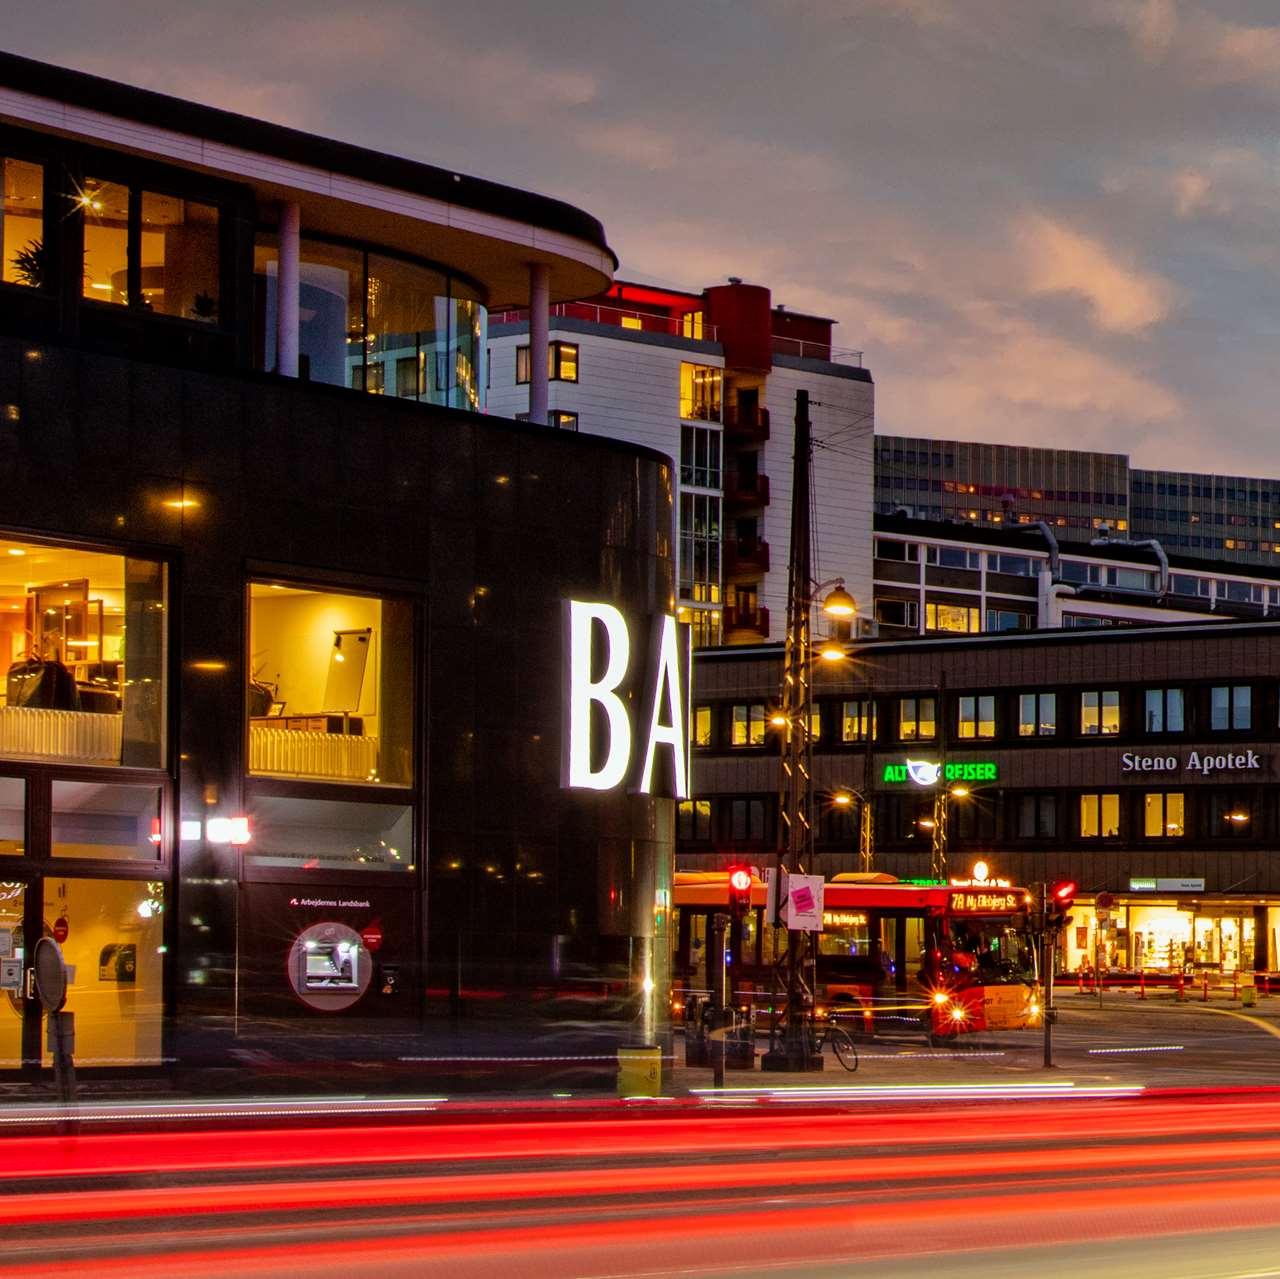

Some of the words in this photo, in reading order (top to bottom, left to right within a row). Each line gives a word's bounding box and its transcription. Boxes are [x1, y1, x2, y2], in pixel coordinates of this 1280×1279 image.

[569, 600, 692, 800] BA
[1122, 752, 1178, 771] Steno
[1186, 750, 1260, 775] Apotek
[884, 765, 908, 782] ALT
[300, 898, 337, 908] Arbejdernes
[338, 899, 370, 908] Landsbank
[952, 893, 964, 910] 7A
